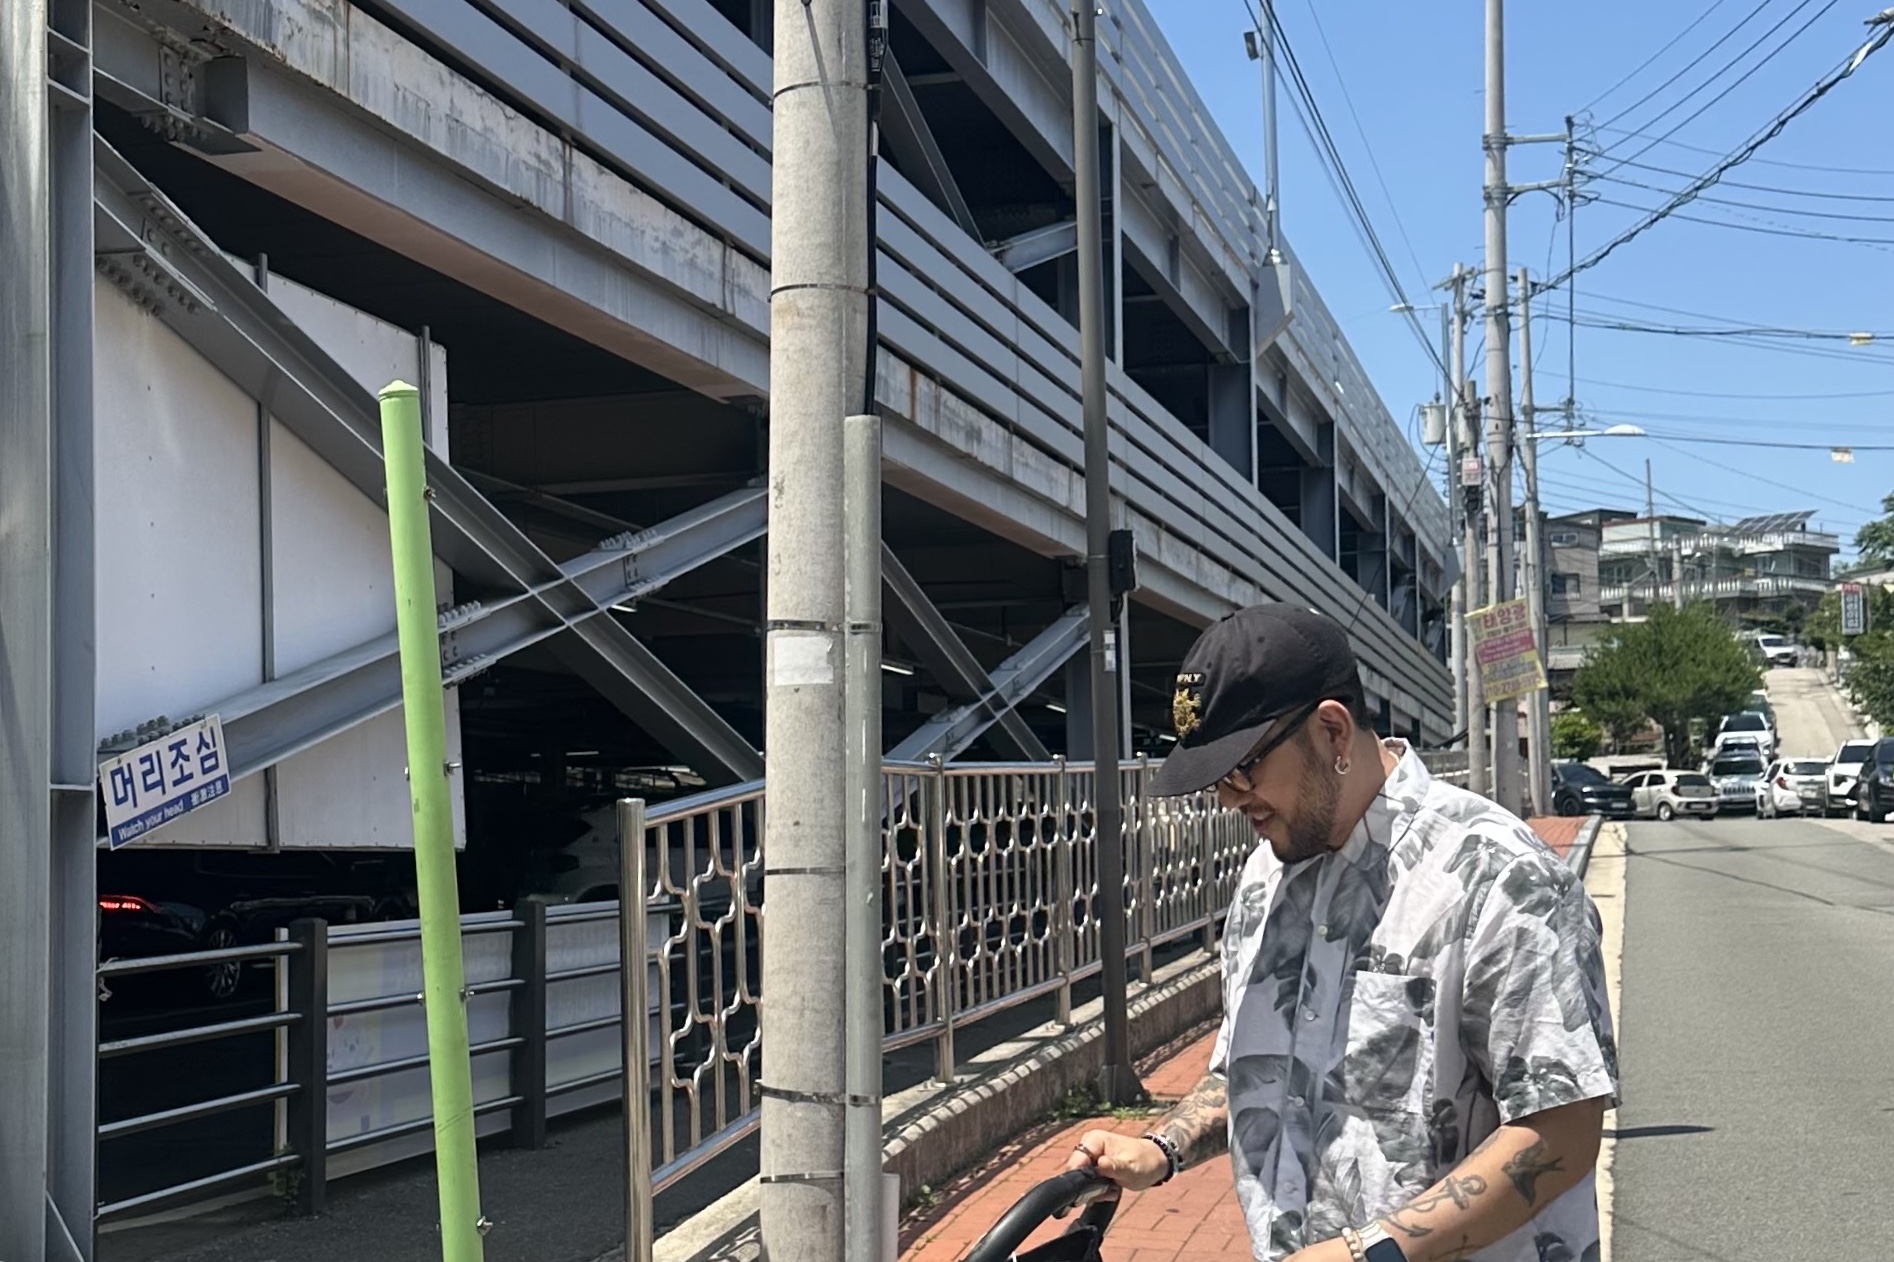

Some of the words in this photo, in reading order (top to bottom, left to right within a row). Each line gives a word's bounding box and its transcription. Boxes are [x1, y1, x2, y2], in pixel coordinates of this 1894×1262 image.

[1483, 602, 1526, 629] 태양광
[110, 726, 219, 808] 머리조심
[118, 819, 145, 841] Watch
[145, 811, 163, 829] your
[163, 799, 185, 819] head
